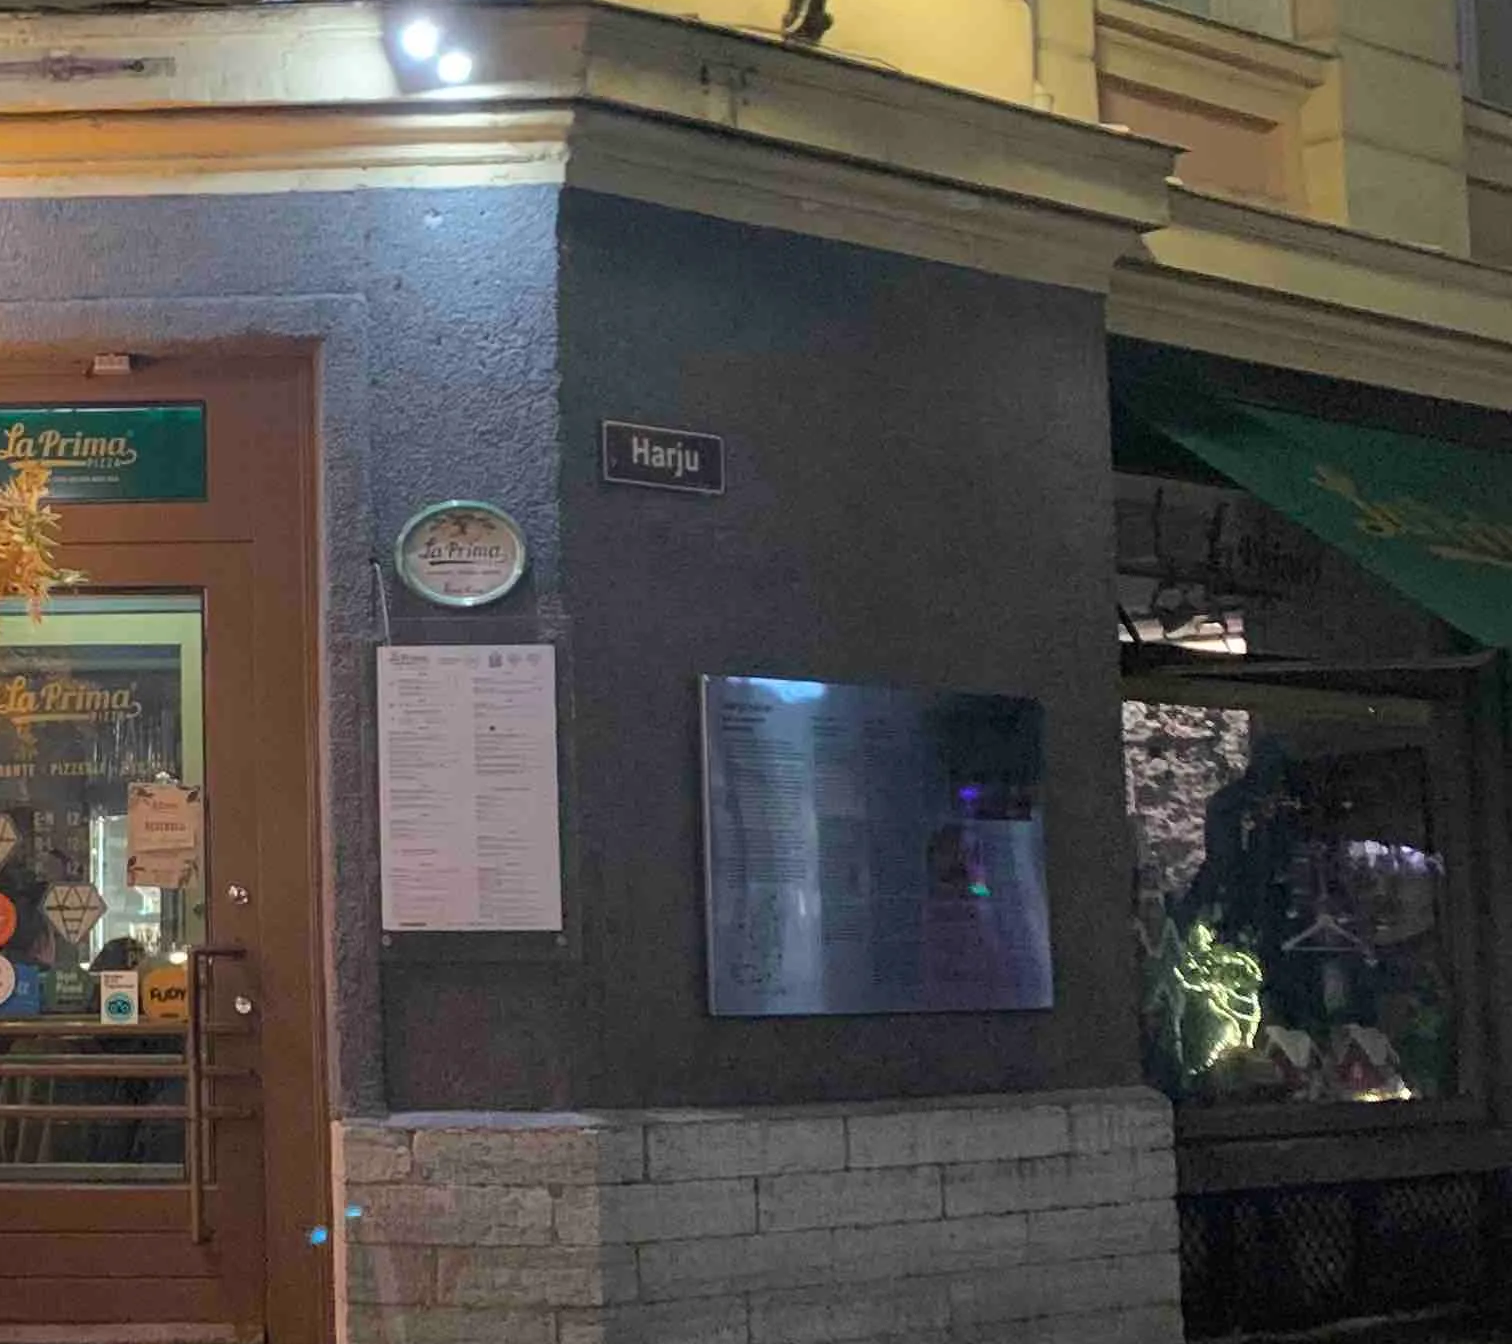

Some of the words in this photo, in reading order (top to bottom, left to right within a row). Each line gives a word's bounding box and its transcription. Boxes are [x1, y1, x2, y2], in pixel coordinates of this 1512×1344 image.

[39, 430, 136, 463] Prima
[632, 436, 699, 477] Harju
[448, 541, 504, 560] Prima
[0, 675, 39, 713] La
[41, 682, 141, 718] Prima
